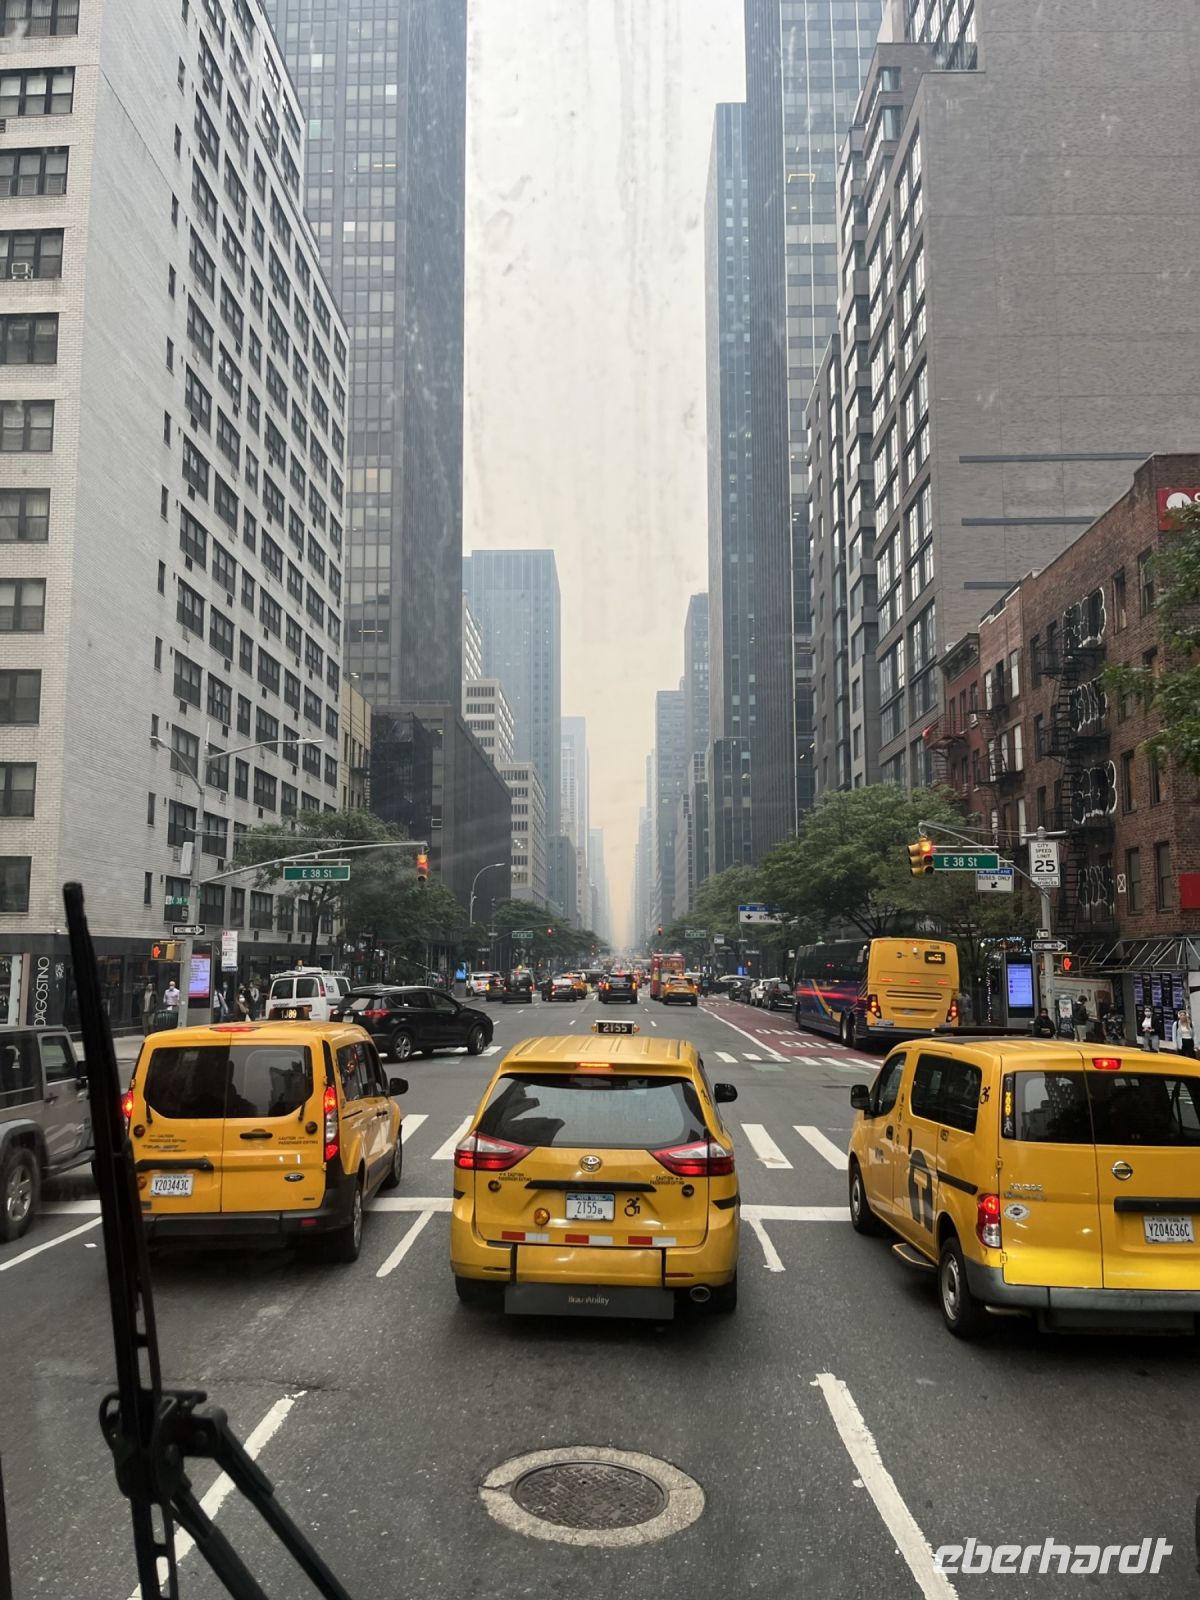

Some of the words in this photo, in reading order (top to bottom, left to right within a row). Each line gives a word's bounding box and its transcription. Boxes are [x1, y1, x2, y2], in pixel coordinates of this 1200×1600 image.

[943, 857, 950, 867] E
[952, 857, 964, 867] 38
[968, 857, 979, 867] St
[1034, 860, 1056, 872] 25
[302, 869, 308, 878] E
[310, 869, 321, 879] 38
[323, 868, 332, 878] St
[603, 1023, 627, 1033] 2T55
[1148, 1223, 1190, 1237] Y204636C
